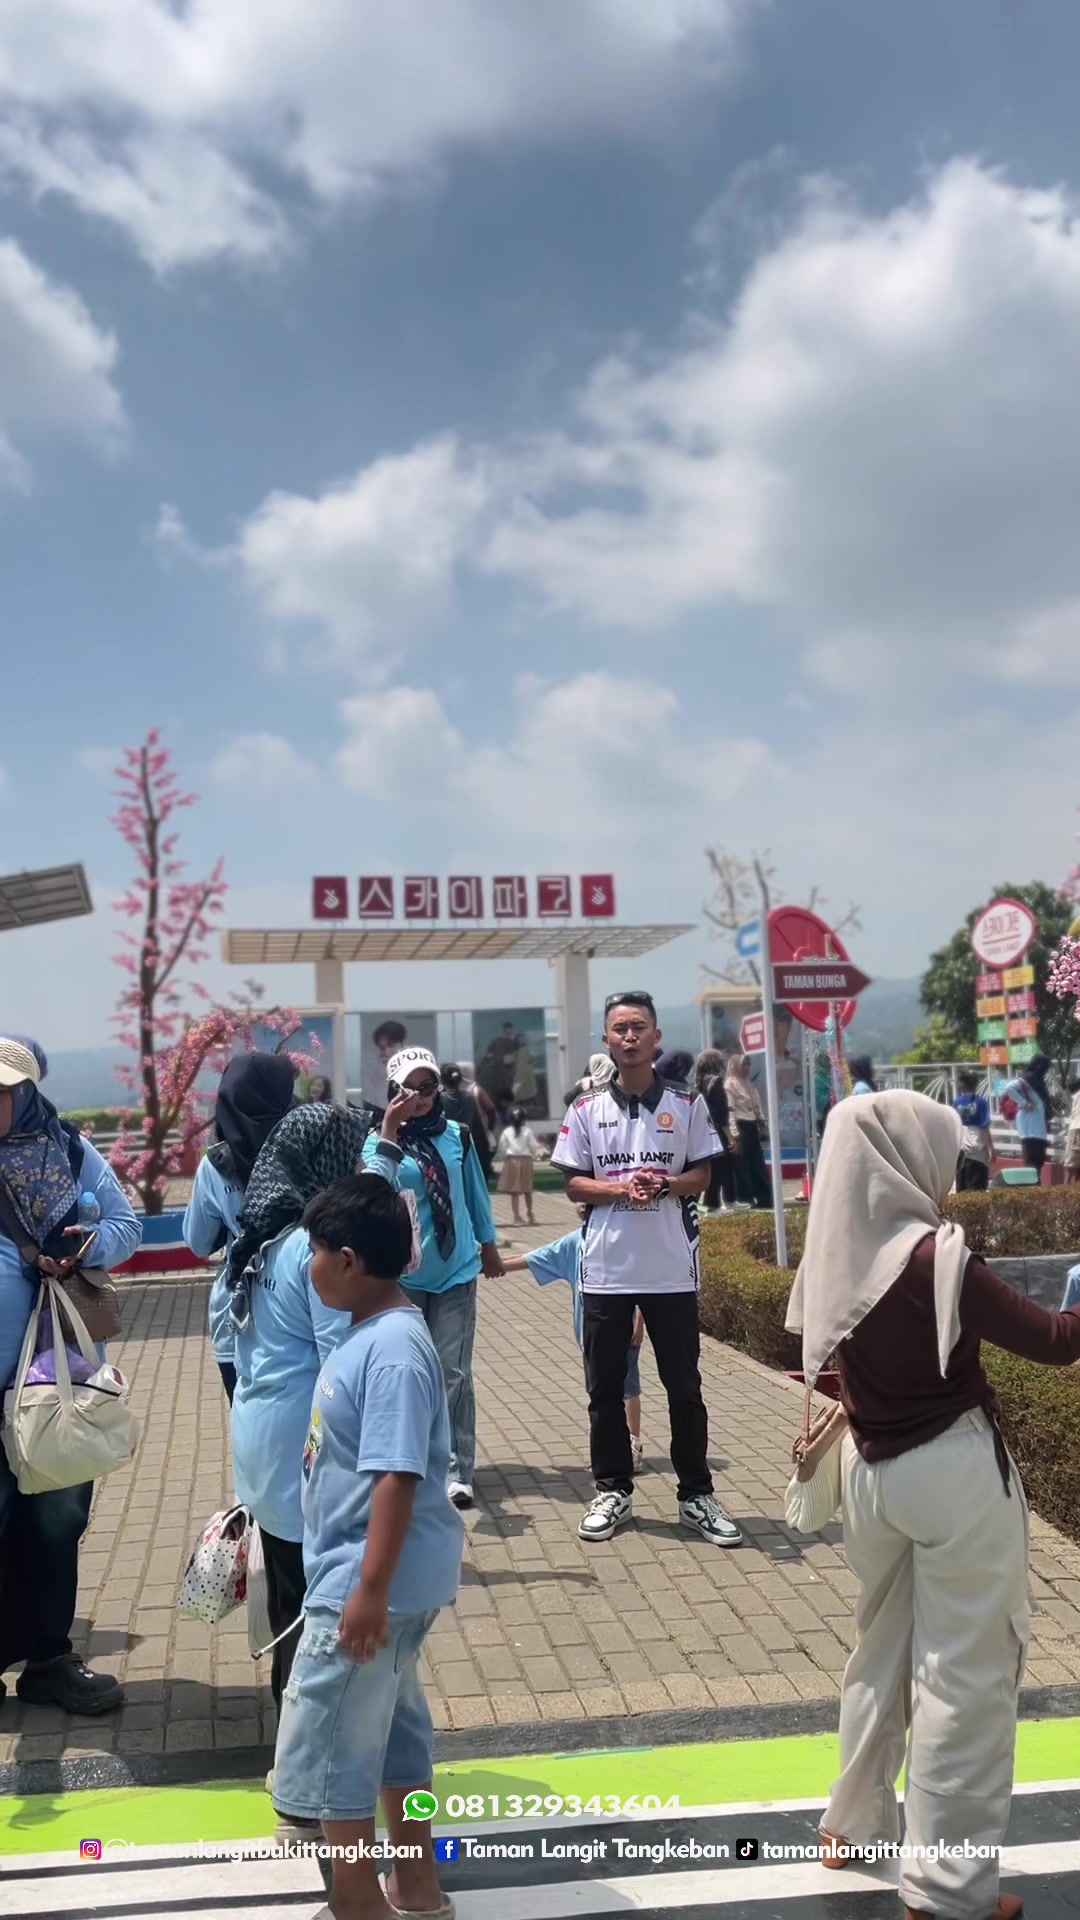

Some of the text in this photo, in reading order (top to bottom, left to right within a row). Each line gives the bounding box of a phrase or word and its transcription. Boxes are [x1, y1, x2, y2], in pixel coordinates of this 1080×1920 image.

[359, 876, 572, 918] 스카이파크
[783, 974, 847, 988] TAMAN BUNGA
[597, 1151, 674, 1168] TAMAN LANGIT
